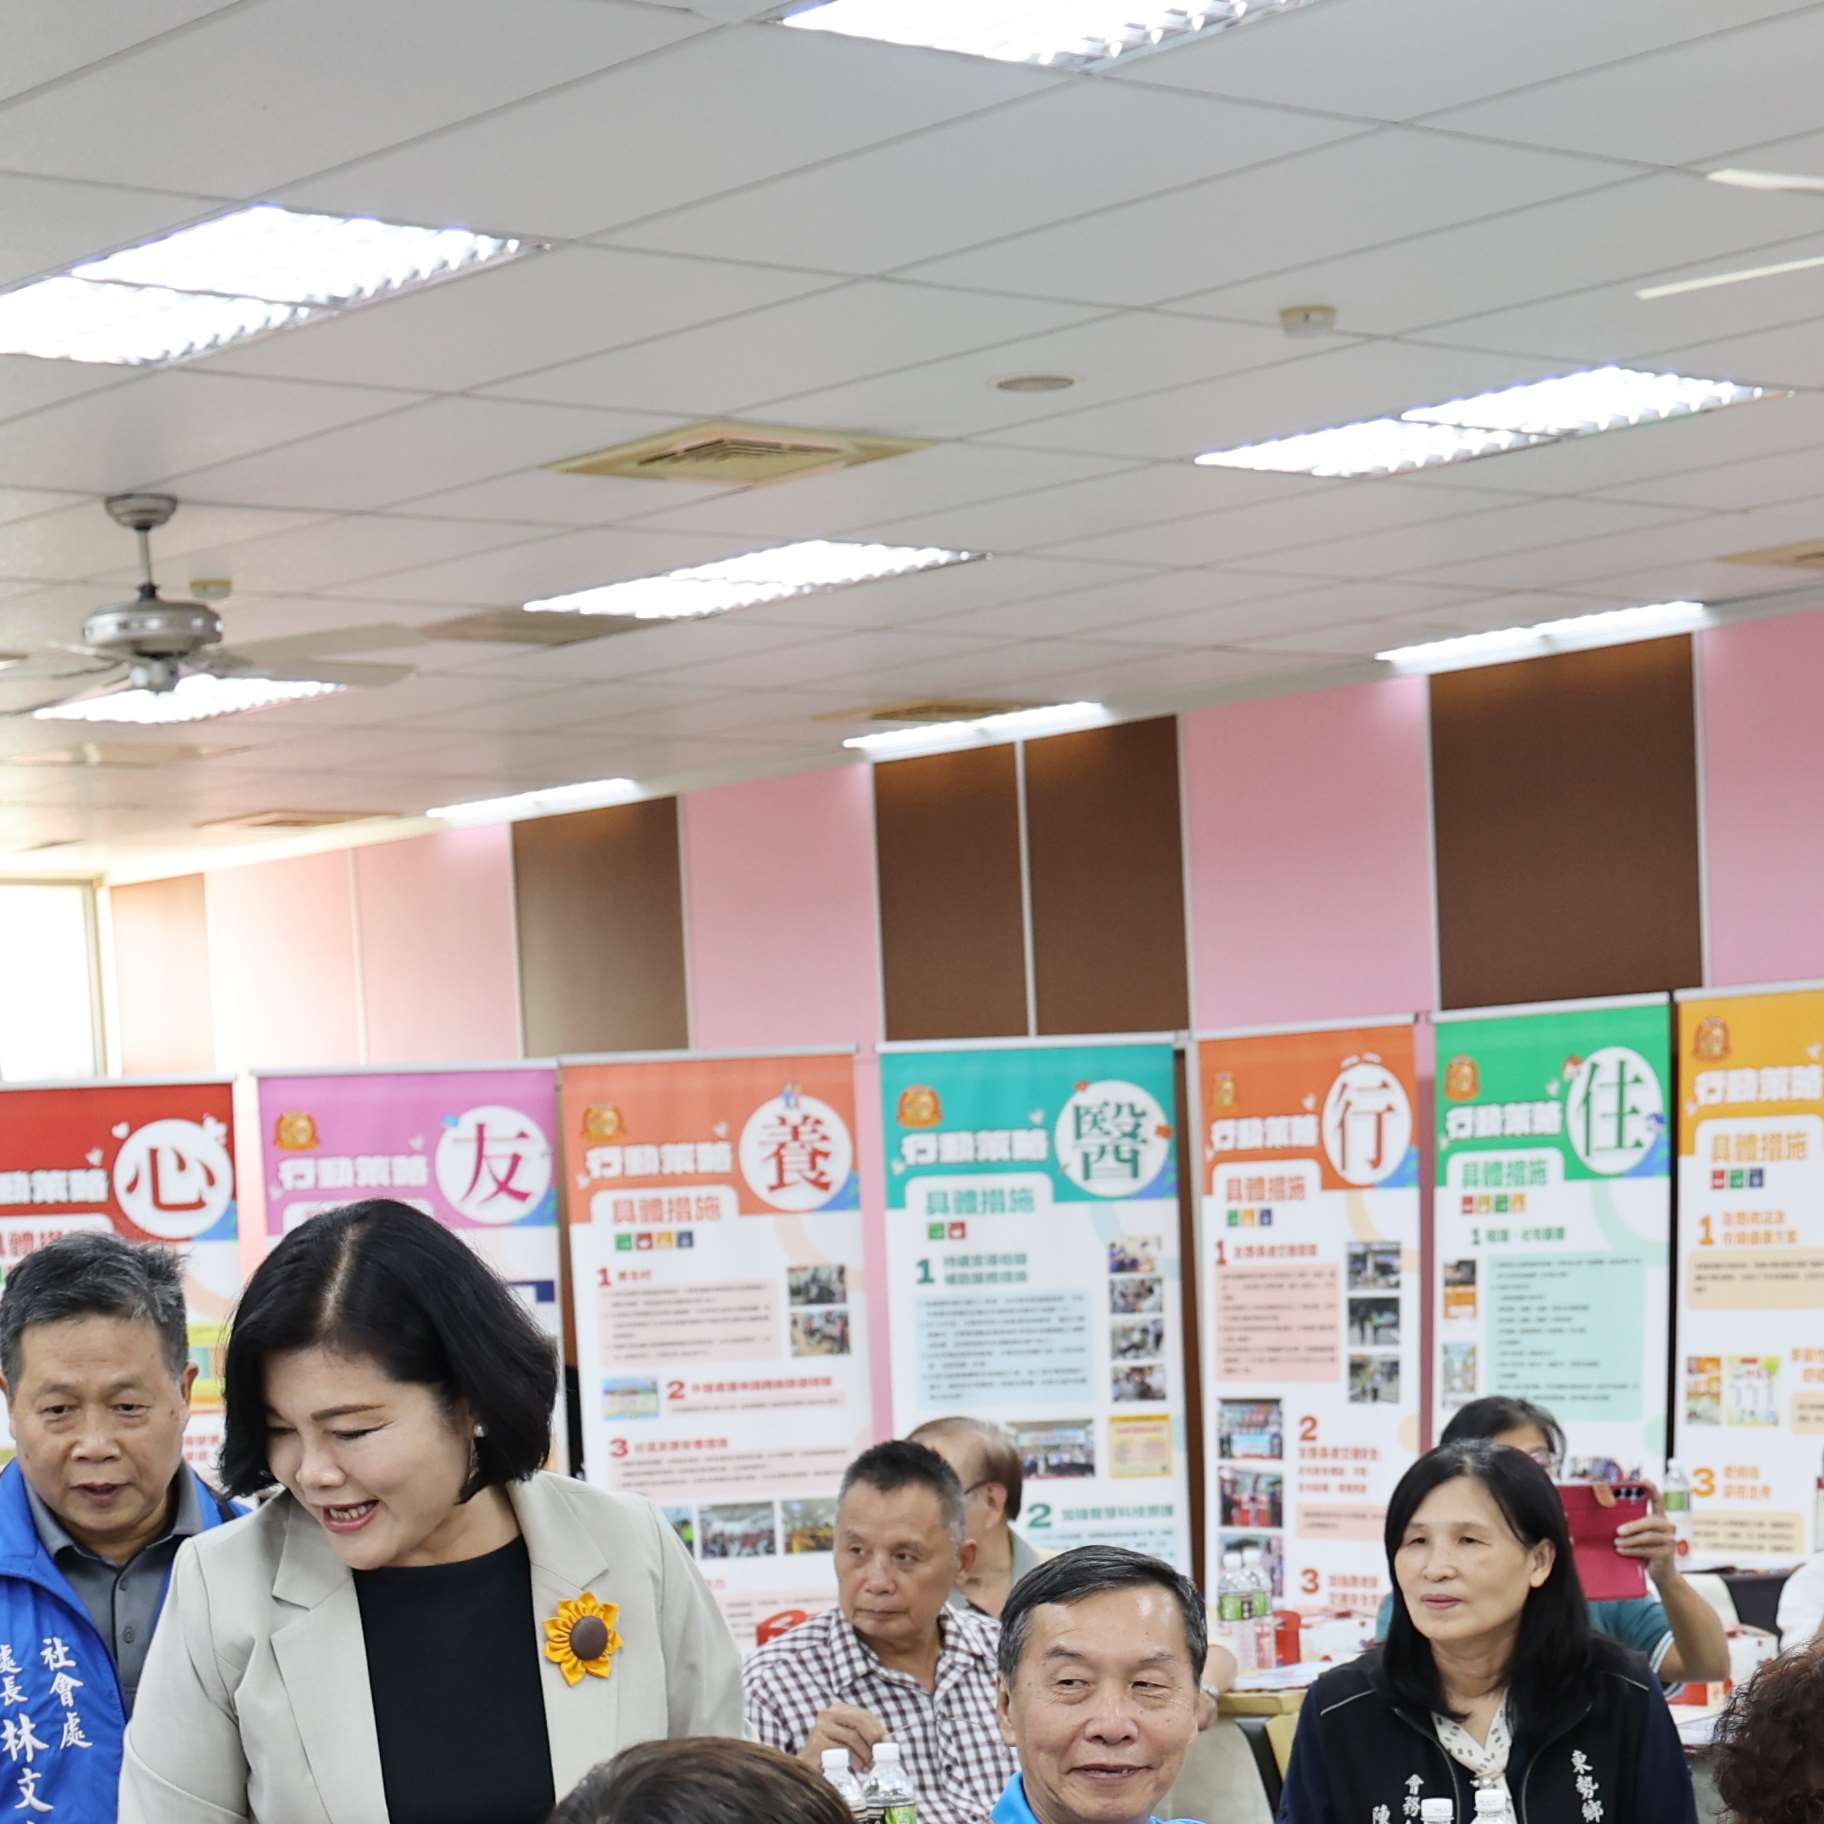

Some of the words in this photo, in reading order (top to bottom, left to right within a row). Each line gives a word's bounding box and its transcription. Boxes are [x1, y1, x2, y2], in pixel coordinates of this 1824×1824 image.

[1577, 1060, 1646, 1159] 住
[1336, 1080, 1397, 1172] 行
[759, 1114, 834, 1193] 養
[1072, 1099, 1150, 1182] 醫
[451, 1121, 534, 1204] 友
[124, 1145, 214, 1212] 心
[1473, 1228, 1480, 1245] 1
[1699, 1215, 1714, 1246] 1
[1216, 1240, 1226, 1265] 1
[597, 1267, 612, 1287] 1
[916, 1259, 934, 1285] 1
[667, 1380, 685, 1400] 2
[1299, 1416, 1318, 1441] 2
[609, 1438, 628, 1457] 3
[1692, 1467, 1715, 1498] 3
[1027, 1503, 1052, 1528] 2
[1301, 1568, 1319, 1594] 3
[42, 1637, 93, 1750] 社會處
